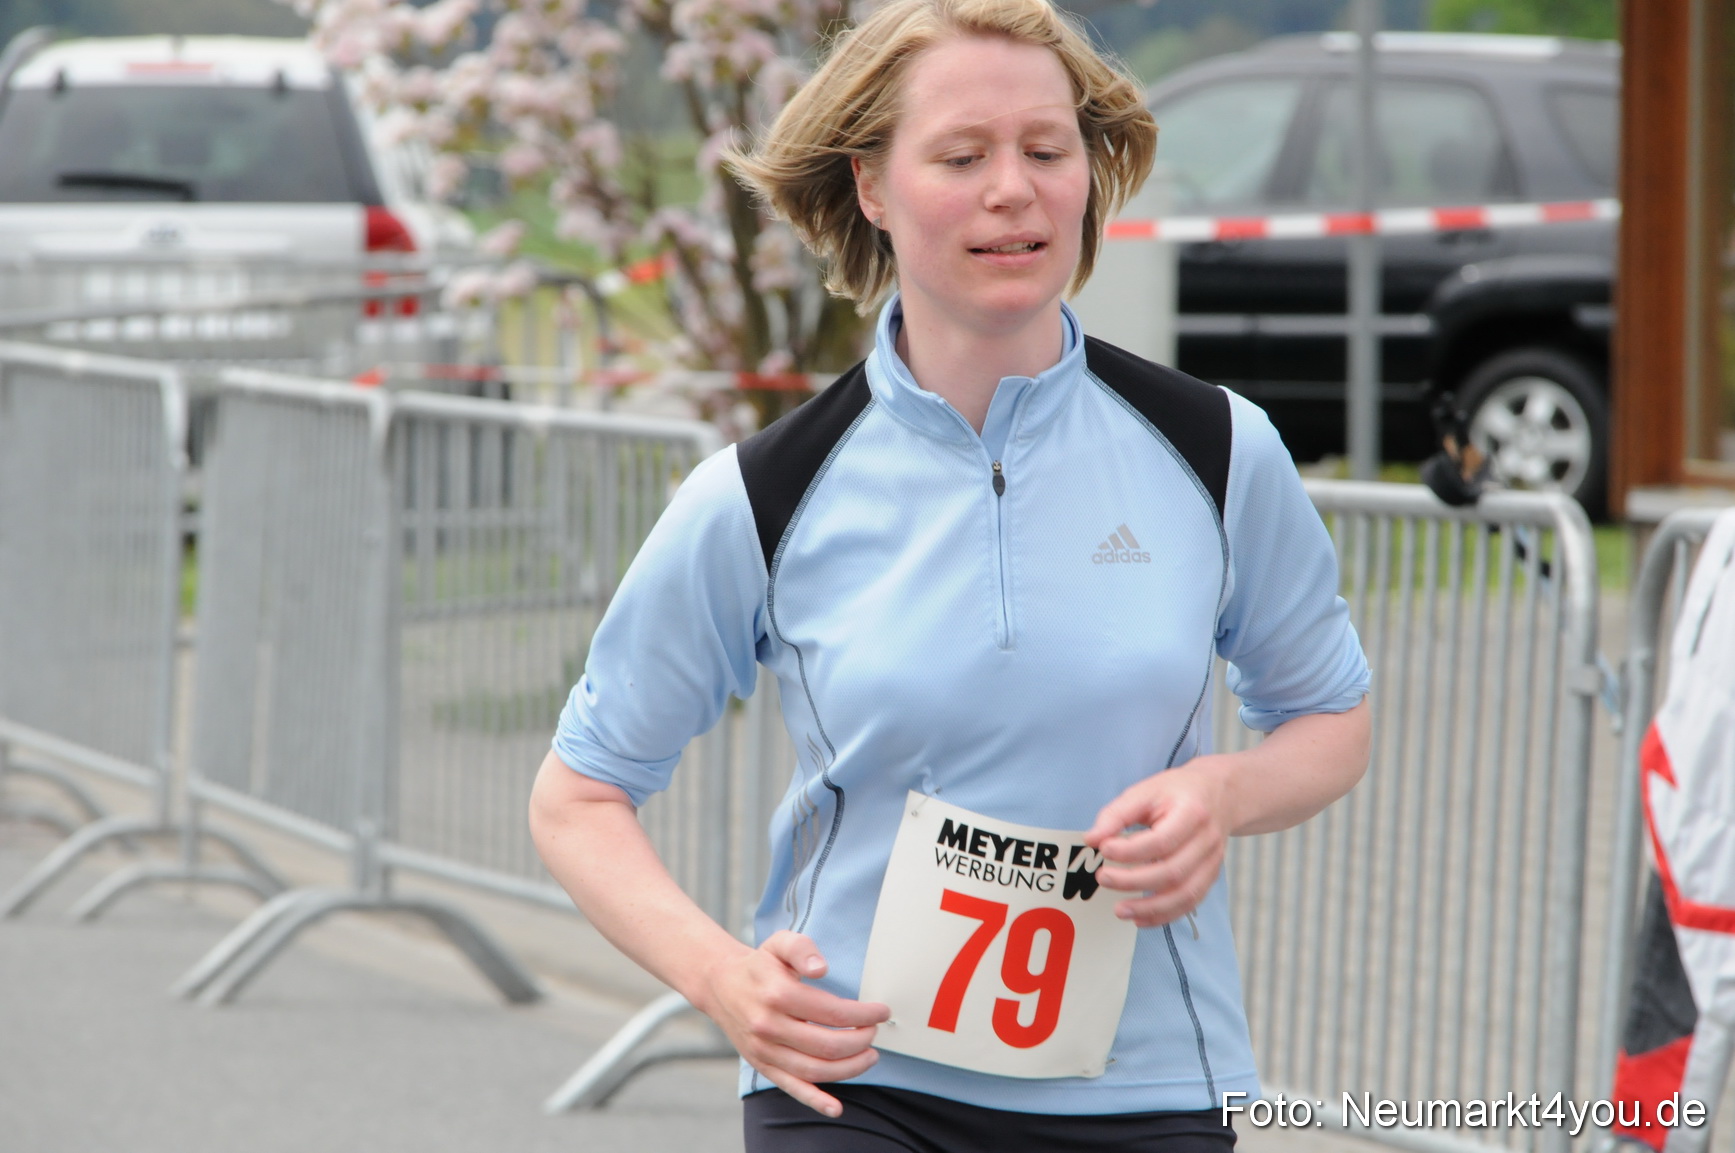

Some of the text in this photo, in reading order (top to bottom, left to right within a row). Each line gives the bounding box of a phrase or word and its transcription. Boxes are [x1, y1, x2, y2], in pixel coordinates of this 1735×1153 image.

[1091, 550, 1152, 565] adidas
[934, 846, 1055, 892] WERBUNG
[936, 818, 1060, 871] MEYER
[927, 888, 1076, 1049] 79
